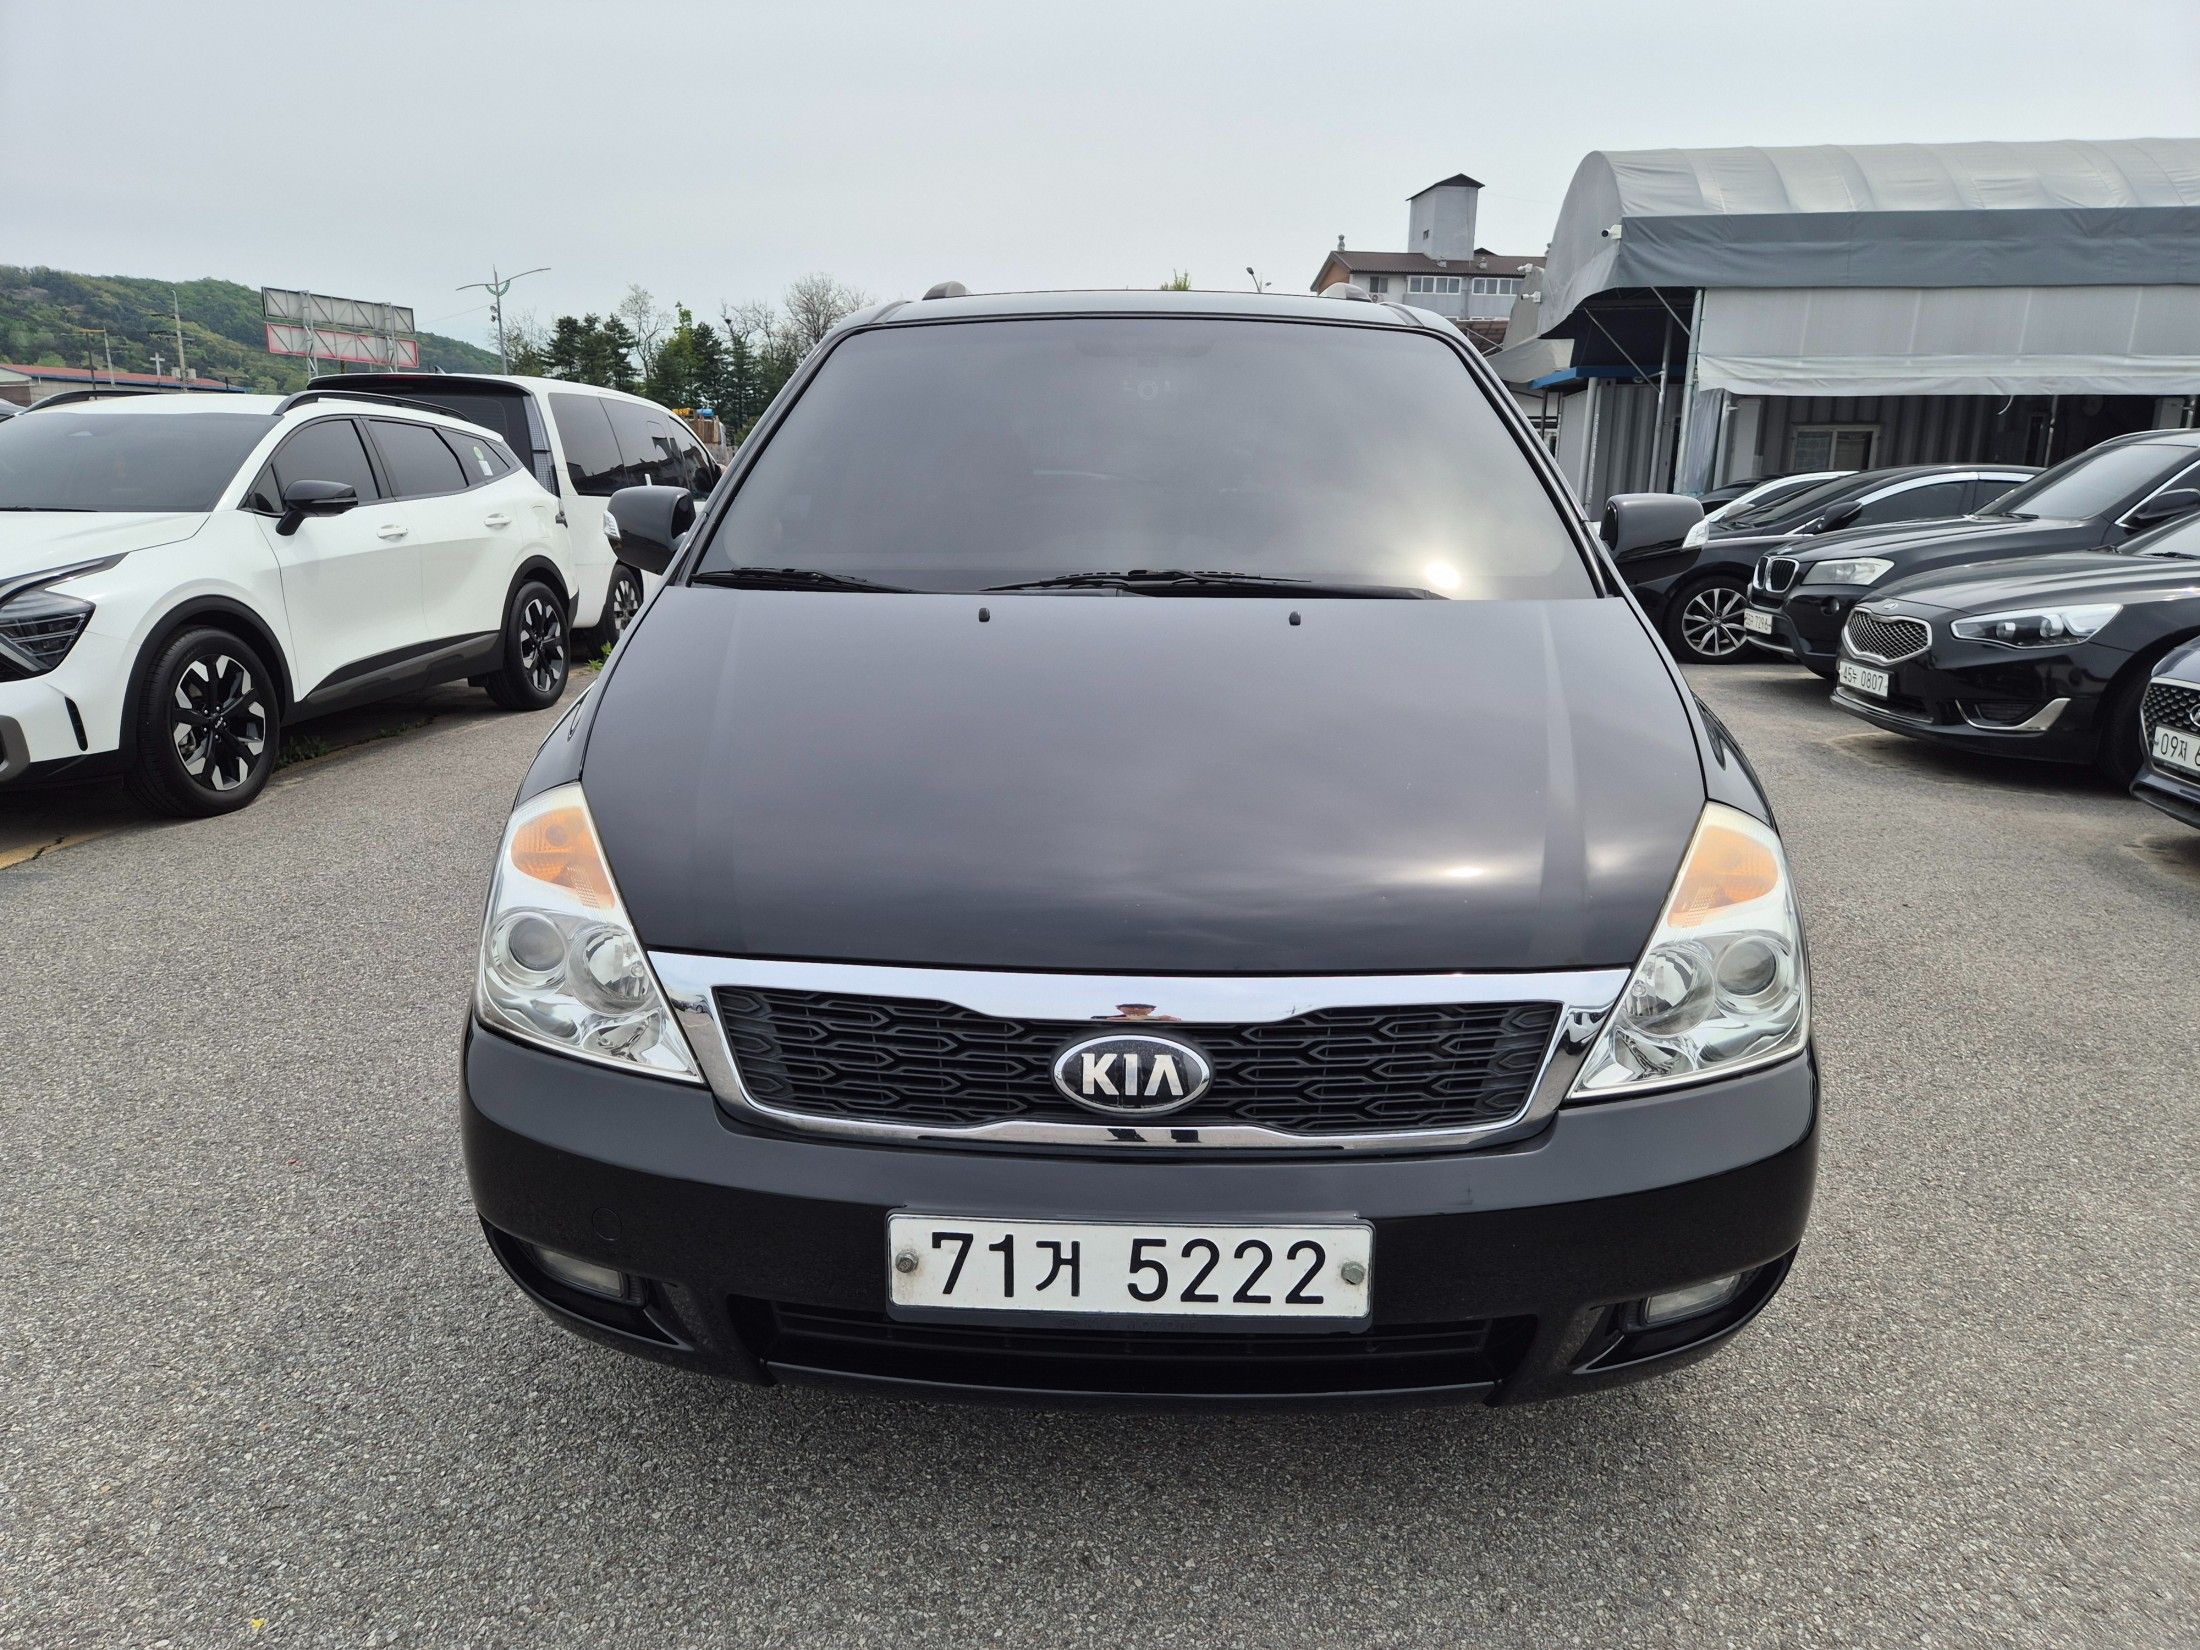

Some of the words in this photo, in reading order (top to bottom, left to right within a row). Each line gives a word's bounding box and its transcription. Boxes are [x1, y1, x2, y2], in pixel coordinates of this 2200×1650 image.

[1861, 670, 1884, 691] 0807
[2160, 732, 2188, 761] 09저
[1081, 1053, 1184, 1096] KIA
[931, 1231, 1081, 1298] 71거
[1127, 1238, 1327, 1304] 5222
